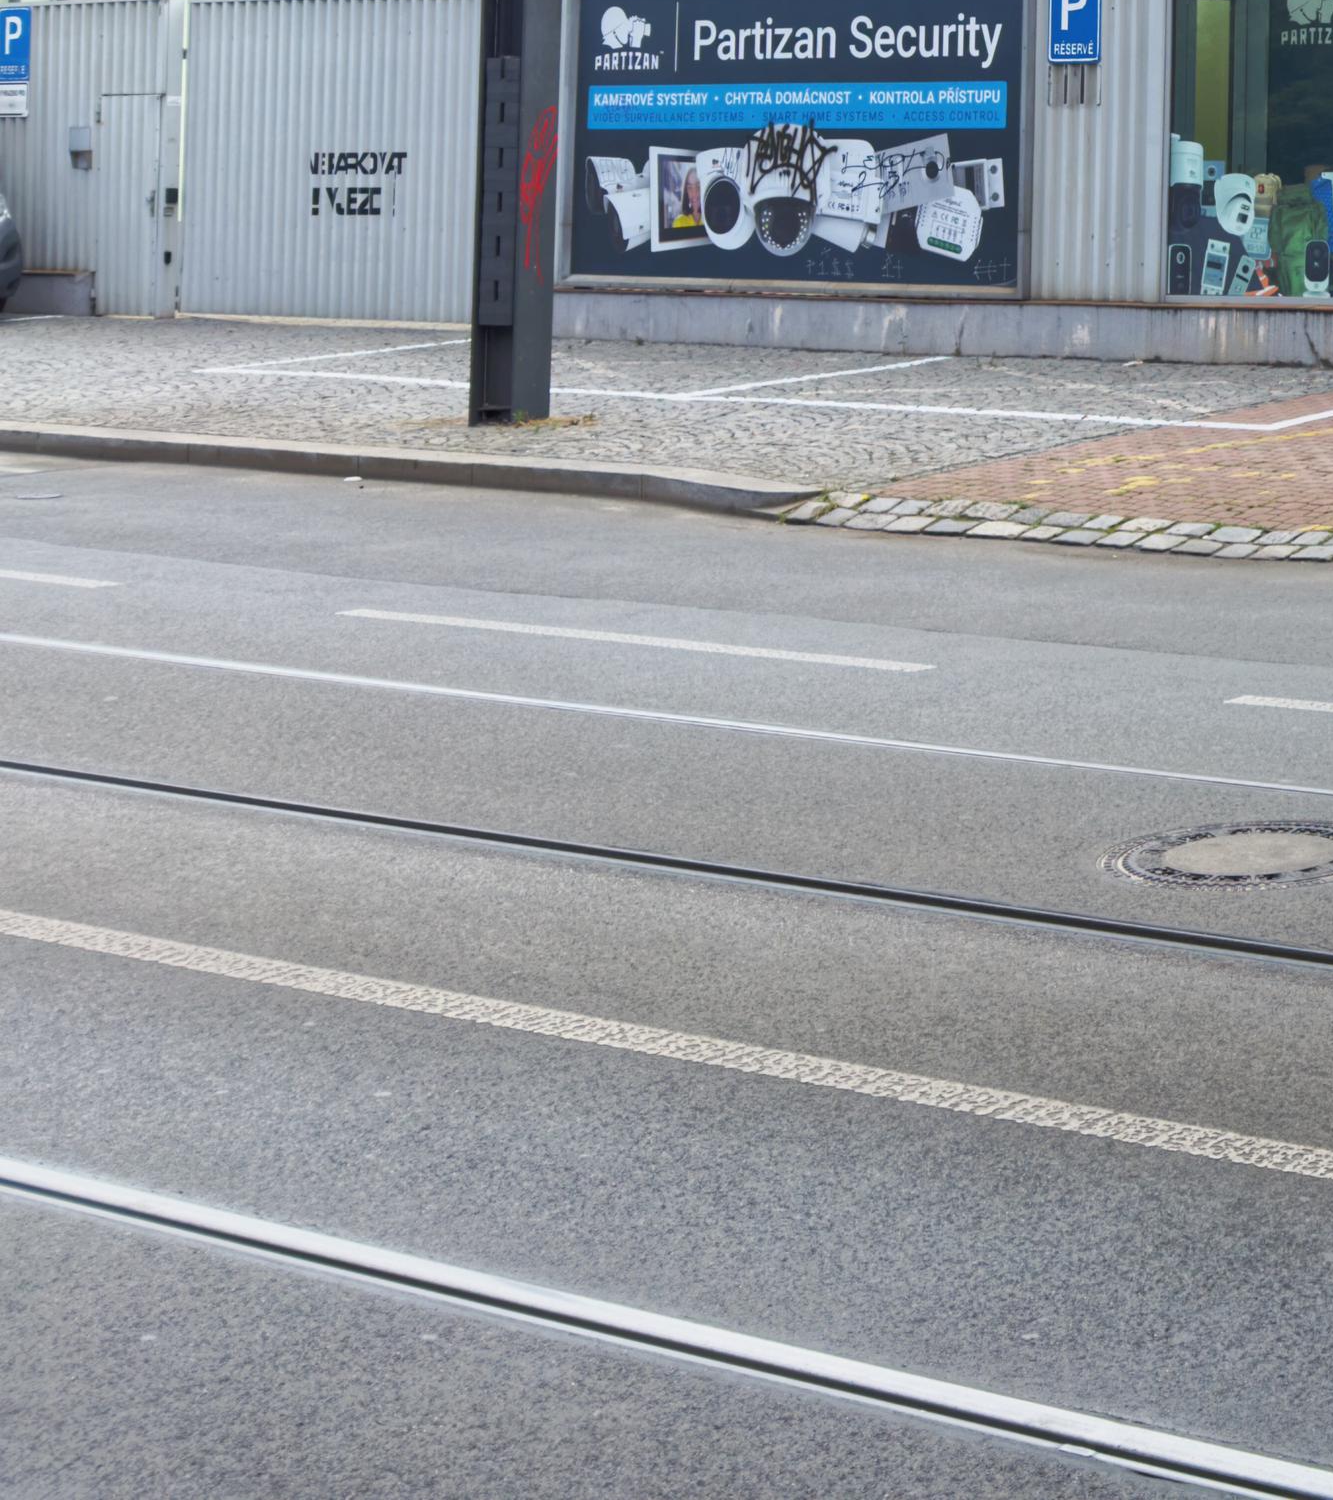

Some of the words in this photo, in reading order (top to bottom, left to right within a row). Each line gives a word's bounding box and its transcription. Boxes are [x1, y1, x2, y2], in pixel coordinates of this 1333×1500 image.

[4, 15, 22, 55] P
[693, 17, 836, 61] Partizan
[849, 12, 1003, 69] Security
[594, 51, 660, 71] PARTIZAN
[593, 90, 654, 107] KAMEROVÉ
[656, 89, 708, 106] SYSTÉMY
[725, 88, 772, 105] CHYTRÁ
[775, 87, 852, 105] DOMÁCNOST
[869, 90, 935, 105] KONTROLA
[938, 87, 1000, 104] PŘÍSTUPU
[624, 112, 695, 123] SURVEILLANCE
[699, 111, 744, 122] SYSTEMS
[762, 110, 798, 122] SMART
[802, 110, 832, 122] HOME
[835, 111, 884, 122] SYSTEMS
[904, 110, 945, 122] ACCESS
[949, 110, 1000, 122] CONTROL
